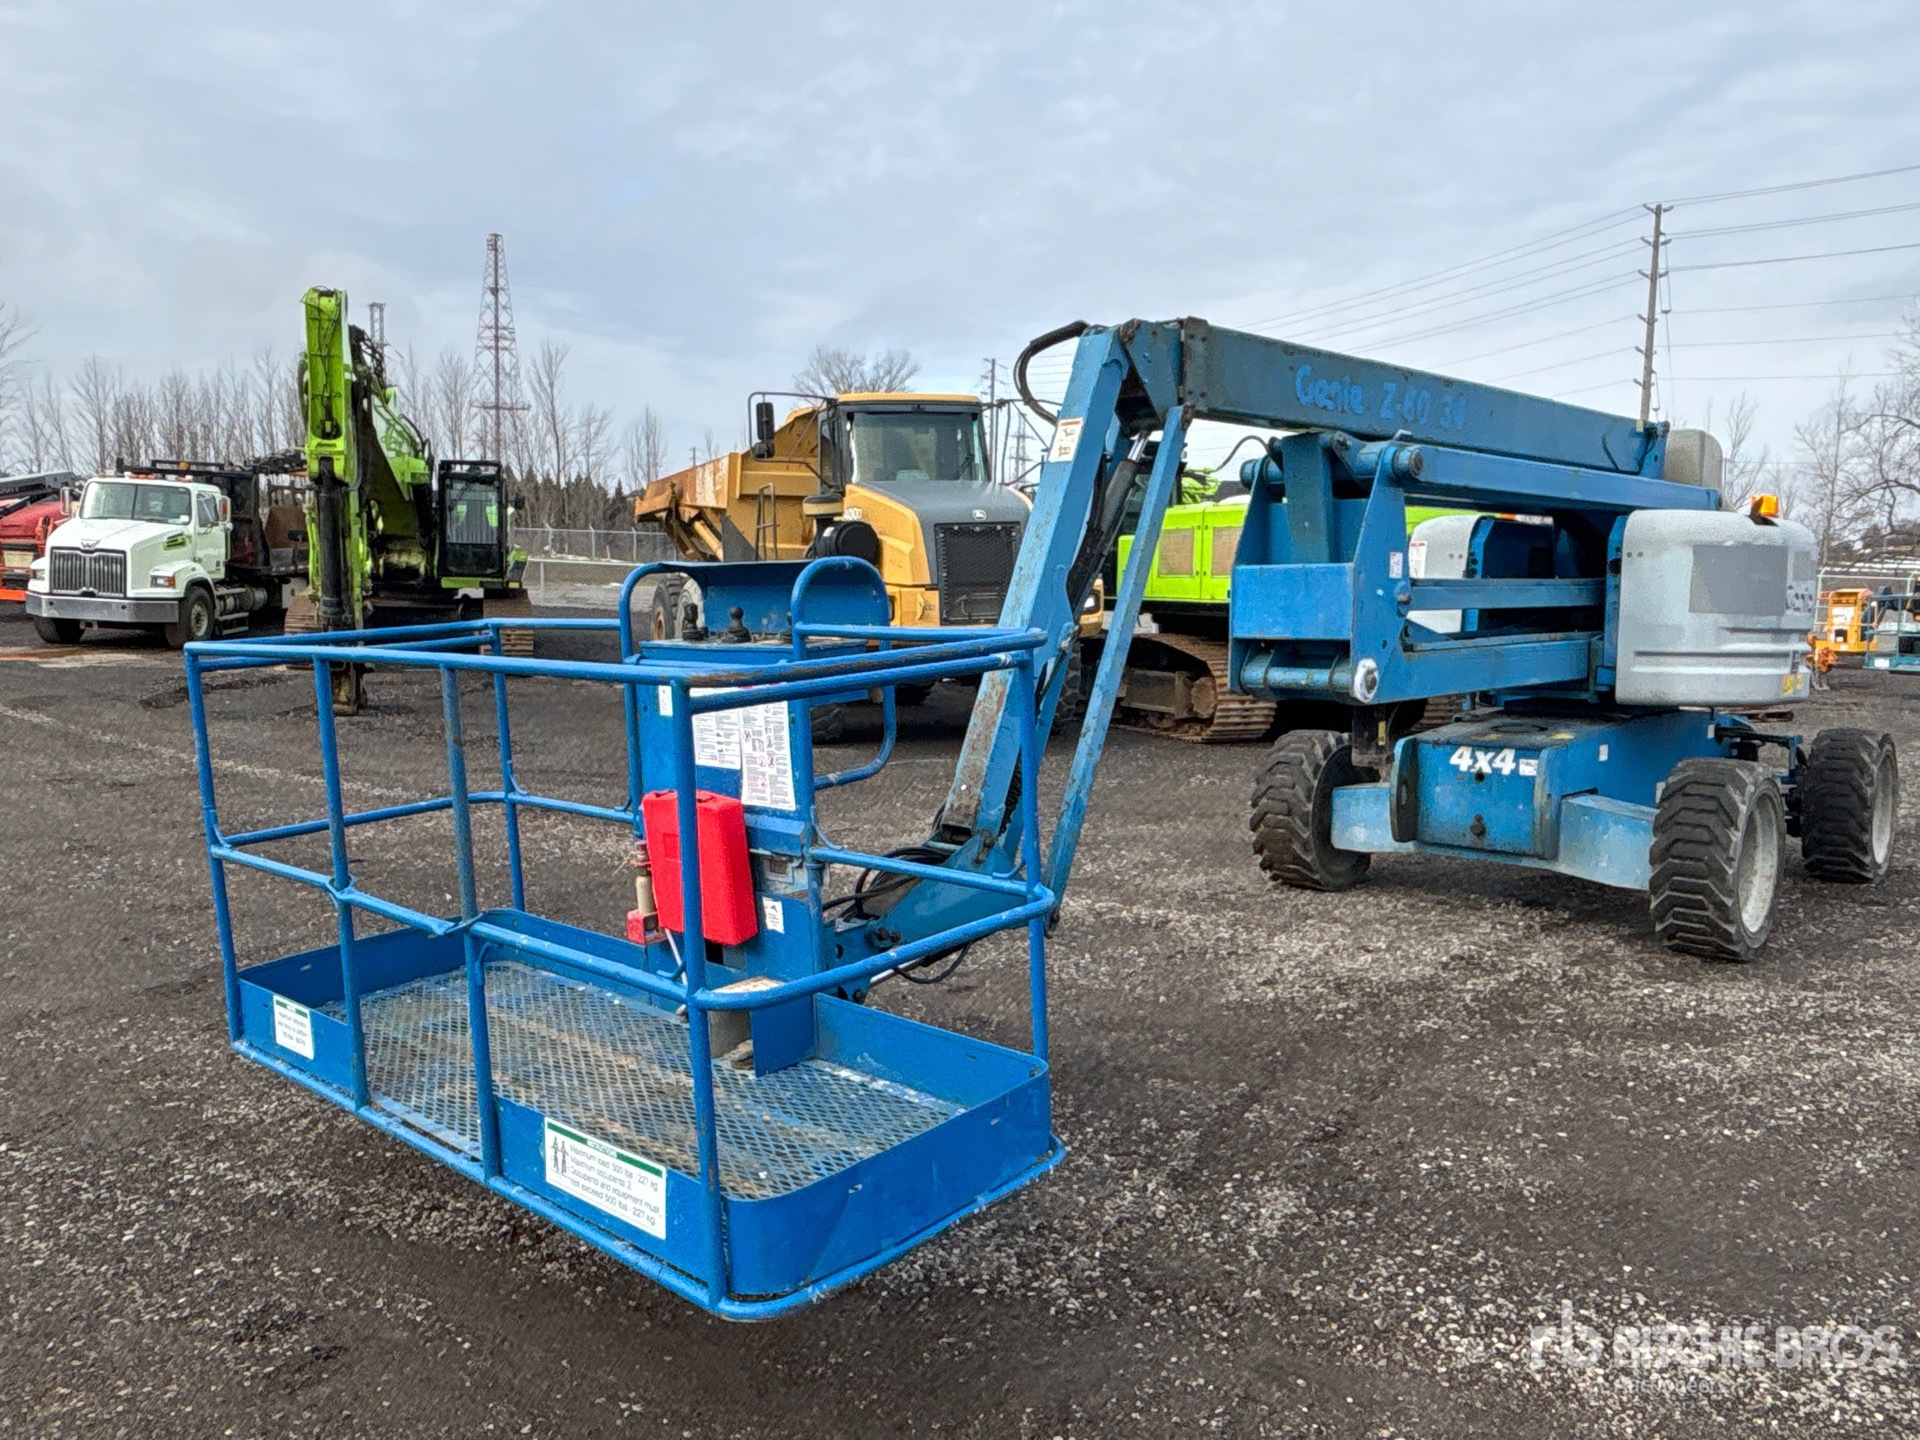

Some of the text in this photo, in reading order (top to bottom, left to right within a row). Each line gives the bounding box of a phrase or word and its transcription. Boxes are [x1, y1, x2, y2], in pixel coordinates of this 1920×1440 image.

[1295, 364, 1364, 414] Genie
[1449, 746, 1516, 775] 4x4
[605, 1194, 617, 1206] 500
